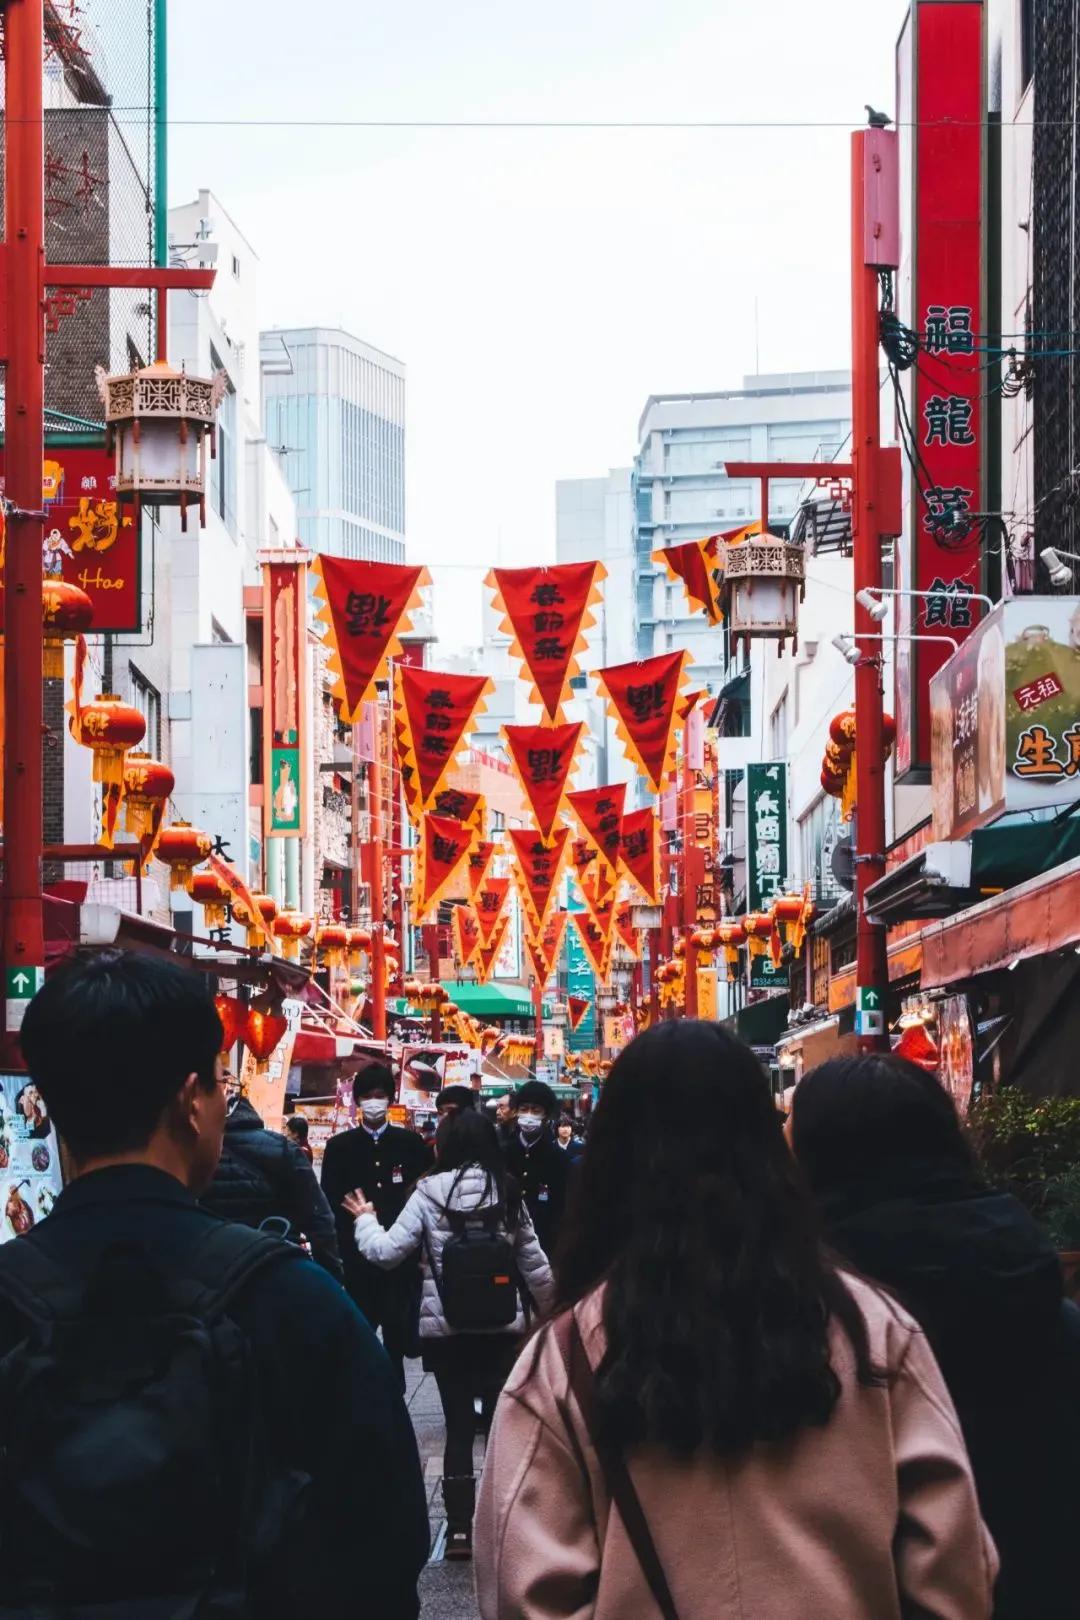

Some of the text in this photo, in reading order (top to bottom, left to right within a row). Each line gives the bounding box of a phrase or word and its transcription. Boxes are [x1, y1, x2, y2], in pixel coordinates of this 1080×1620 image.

[924, 305, 976, 629] 福龍菜館
[78, 567, 125, 590] Hao
[346, 592, 391, 638] 福
[1019, 677, 1060, 708] 元祖
